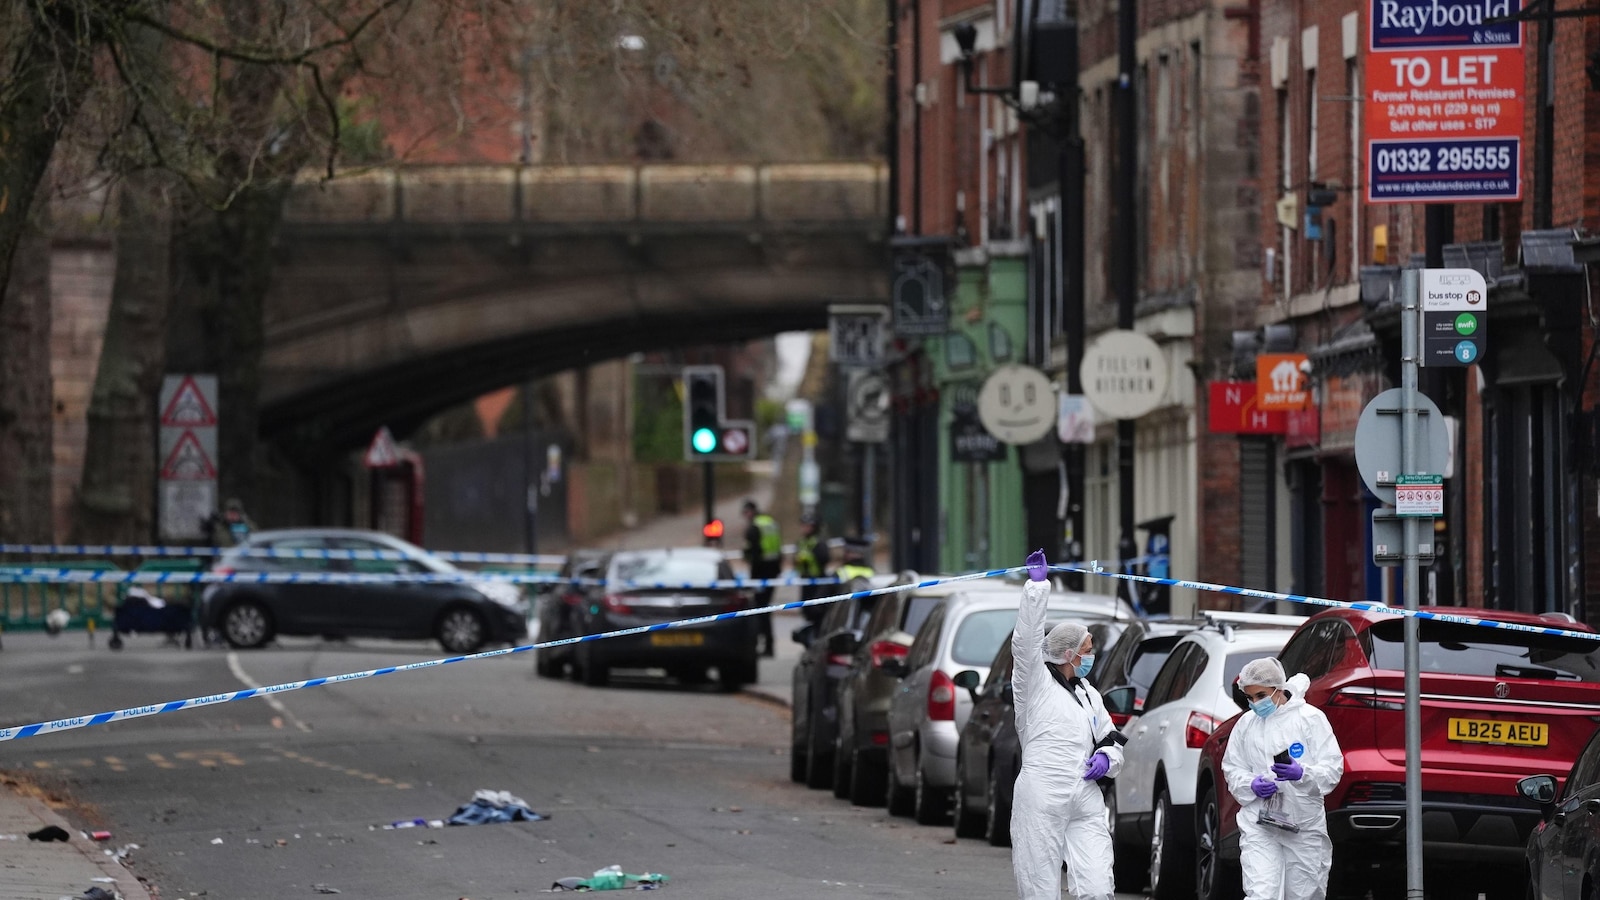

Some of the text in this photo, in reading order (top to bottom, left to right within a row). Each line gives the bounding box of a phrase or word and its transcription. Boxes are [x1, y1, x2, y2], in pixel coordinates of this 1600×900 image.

[1380, 0, 1510, 35] Raybould
[1473, 30, 1511, 43] & Sons
[1391, 55, 1498, 87] TO LET
[1373, 87, 1516, 102] Former Restaurant Premises
[1388, 102, 1501, 118] 2,470 sq ft (229 sq m)
[1390, 119, 1410, 132] Suit
[1412, 119, 1438, 132] other
[1440, 120, 1465, 131] uses
[1474, 117, 1497, 130] STP
[1377, 146, 1511, 173] 01332 295555
[1377, 179, 1510, 194] www.raybouldandsons.co.uk
[1428, 290, 1443, 300] bus
[1445, 291, 1463, 301] stop
[1458, 320, 1474, 329] swift
[1462, 349, 1470, 360] 8
[1225, 387, 1241, 406] N
[1264, 392, 1306, 405] JUST EAT
[1252, 411, 1267, 429] H
[194, 692, 227, 705] POLICE
[123, 704, 156, 717] POLICE
[51, 717, 84, 729] POLICE
[1456, 720, 1541, 742] LB25 AEU
